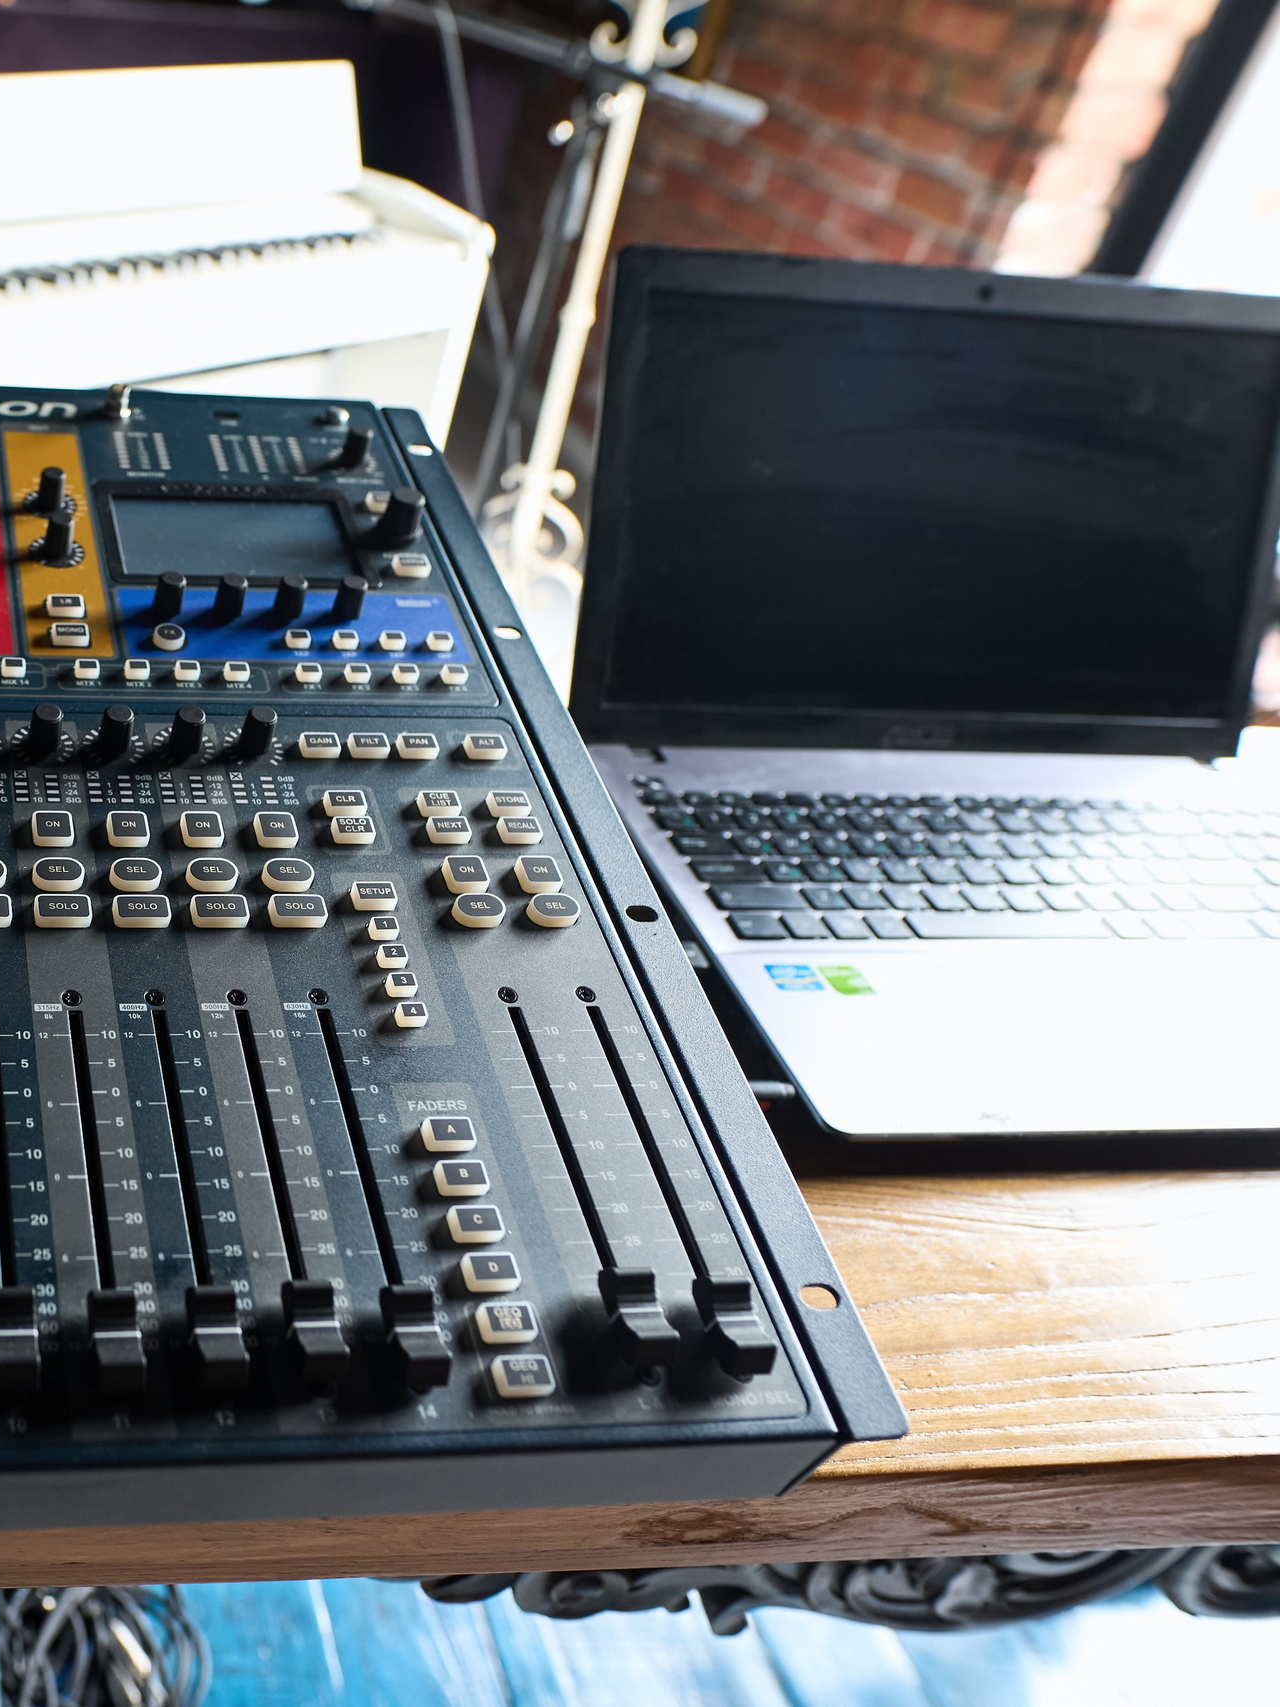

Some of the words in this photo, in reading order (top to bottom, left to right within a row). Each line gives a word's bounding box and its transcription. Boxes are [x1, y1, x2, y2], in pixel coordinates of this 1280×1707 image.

[56, 626, 84, 634] MONO
[245, 681, 253, 690] 4
[335, 795, 356, 803] CLR
[428, 792, 451, 800] CUE
[495, 796, 527, 804] STORE
[506, 821, 536, 830] RECALL
[359, 887, 392, 896] SETUP
[382, 920, 389, 929] 1
[407, 1100, 468, 1113] FADERS
[447, 1125, 456, 1134] A
[459, 1168, 470, 1178] B
[472, 1214, 483, 1224] C
[488, 1262, 499, 1272] D
